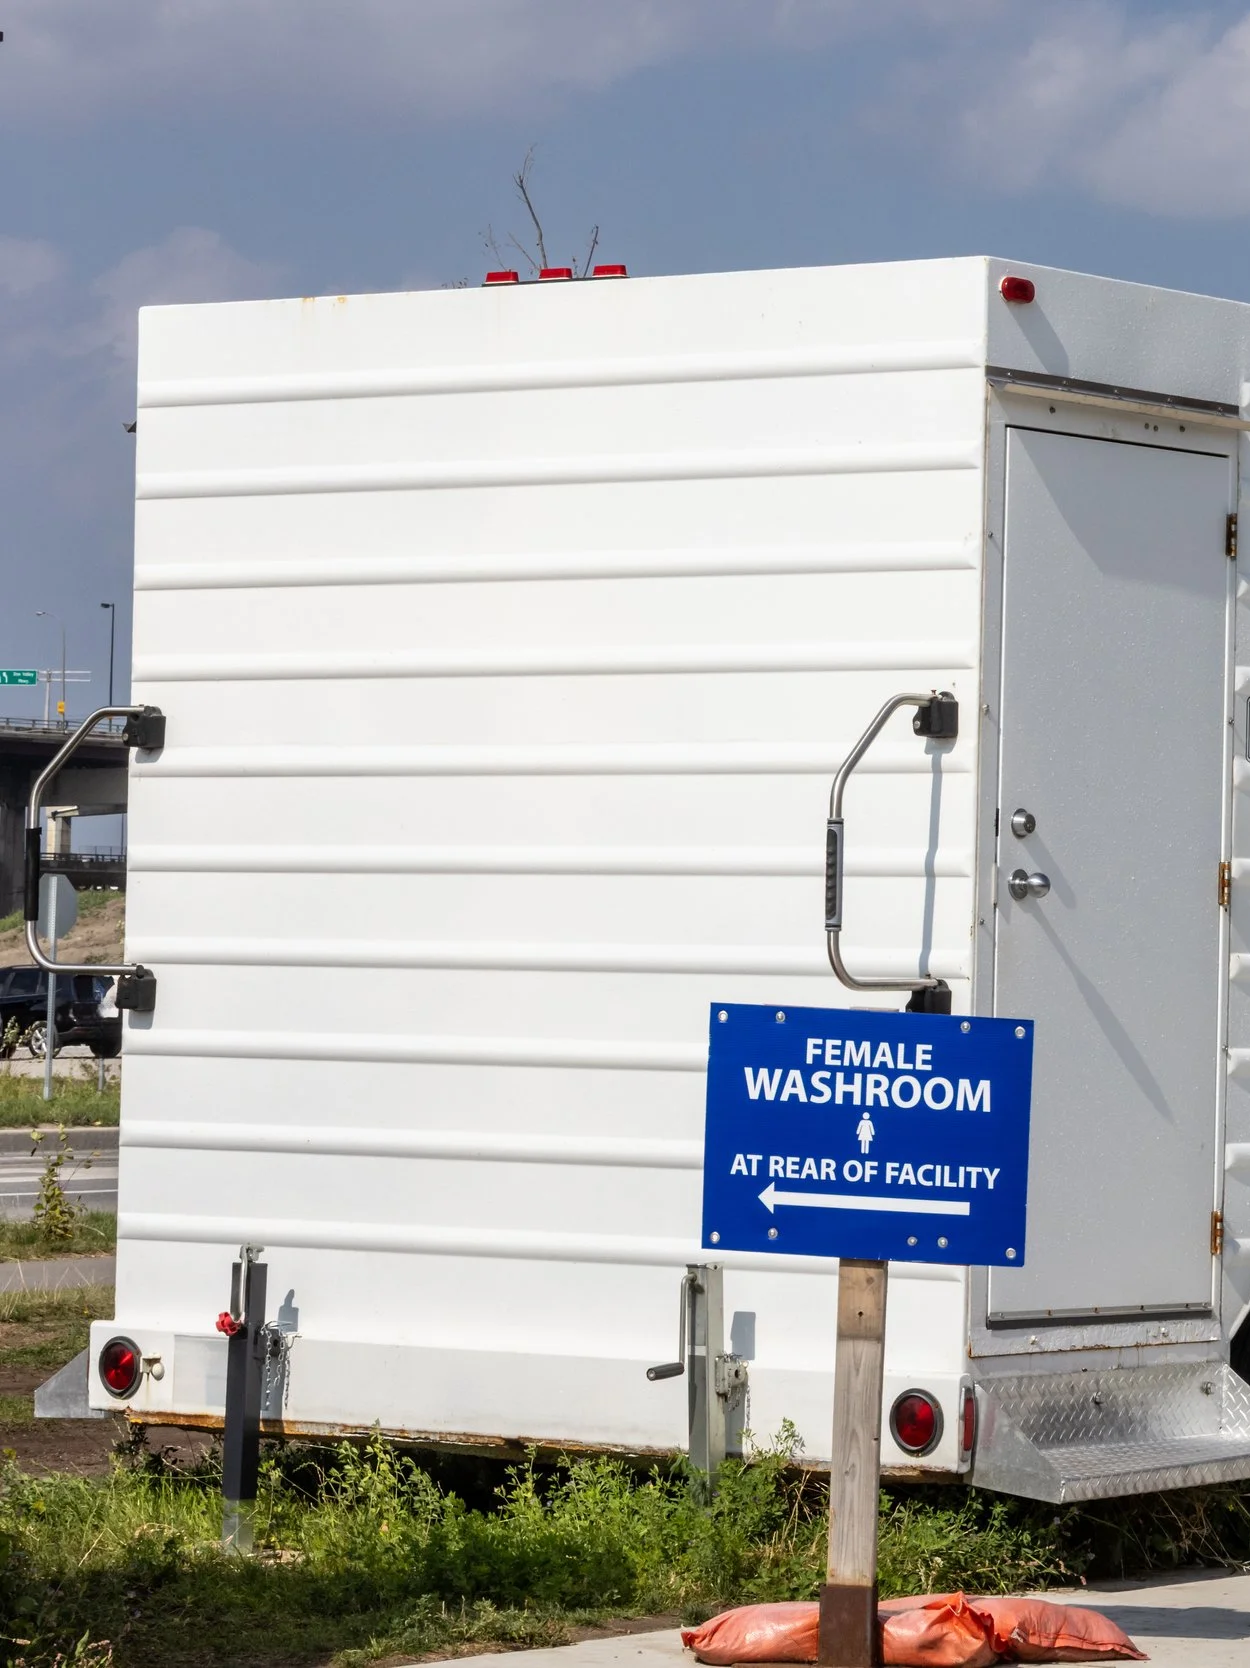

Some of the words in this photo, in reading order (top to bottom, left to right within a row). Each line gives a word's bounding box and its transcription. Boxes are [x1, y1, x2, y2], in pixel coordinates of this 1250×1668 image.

[805, 1037, 933, 1071] FEMALE
[743, 1066, 991, 1113] WASHROOM
[730, 1153, 763, 1176] AT
[768, 1155, 837, 1181] REAR
[842, 1159, 879, 1183] OF
[885, 1162, 1001, 1190] FACILITY
